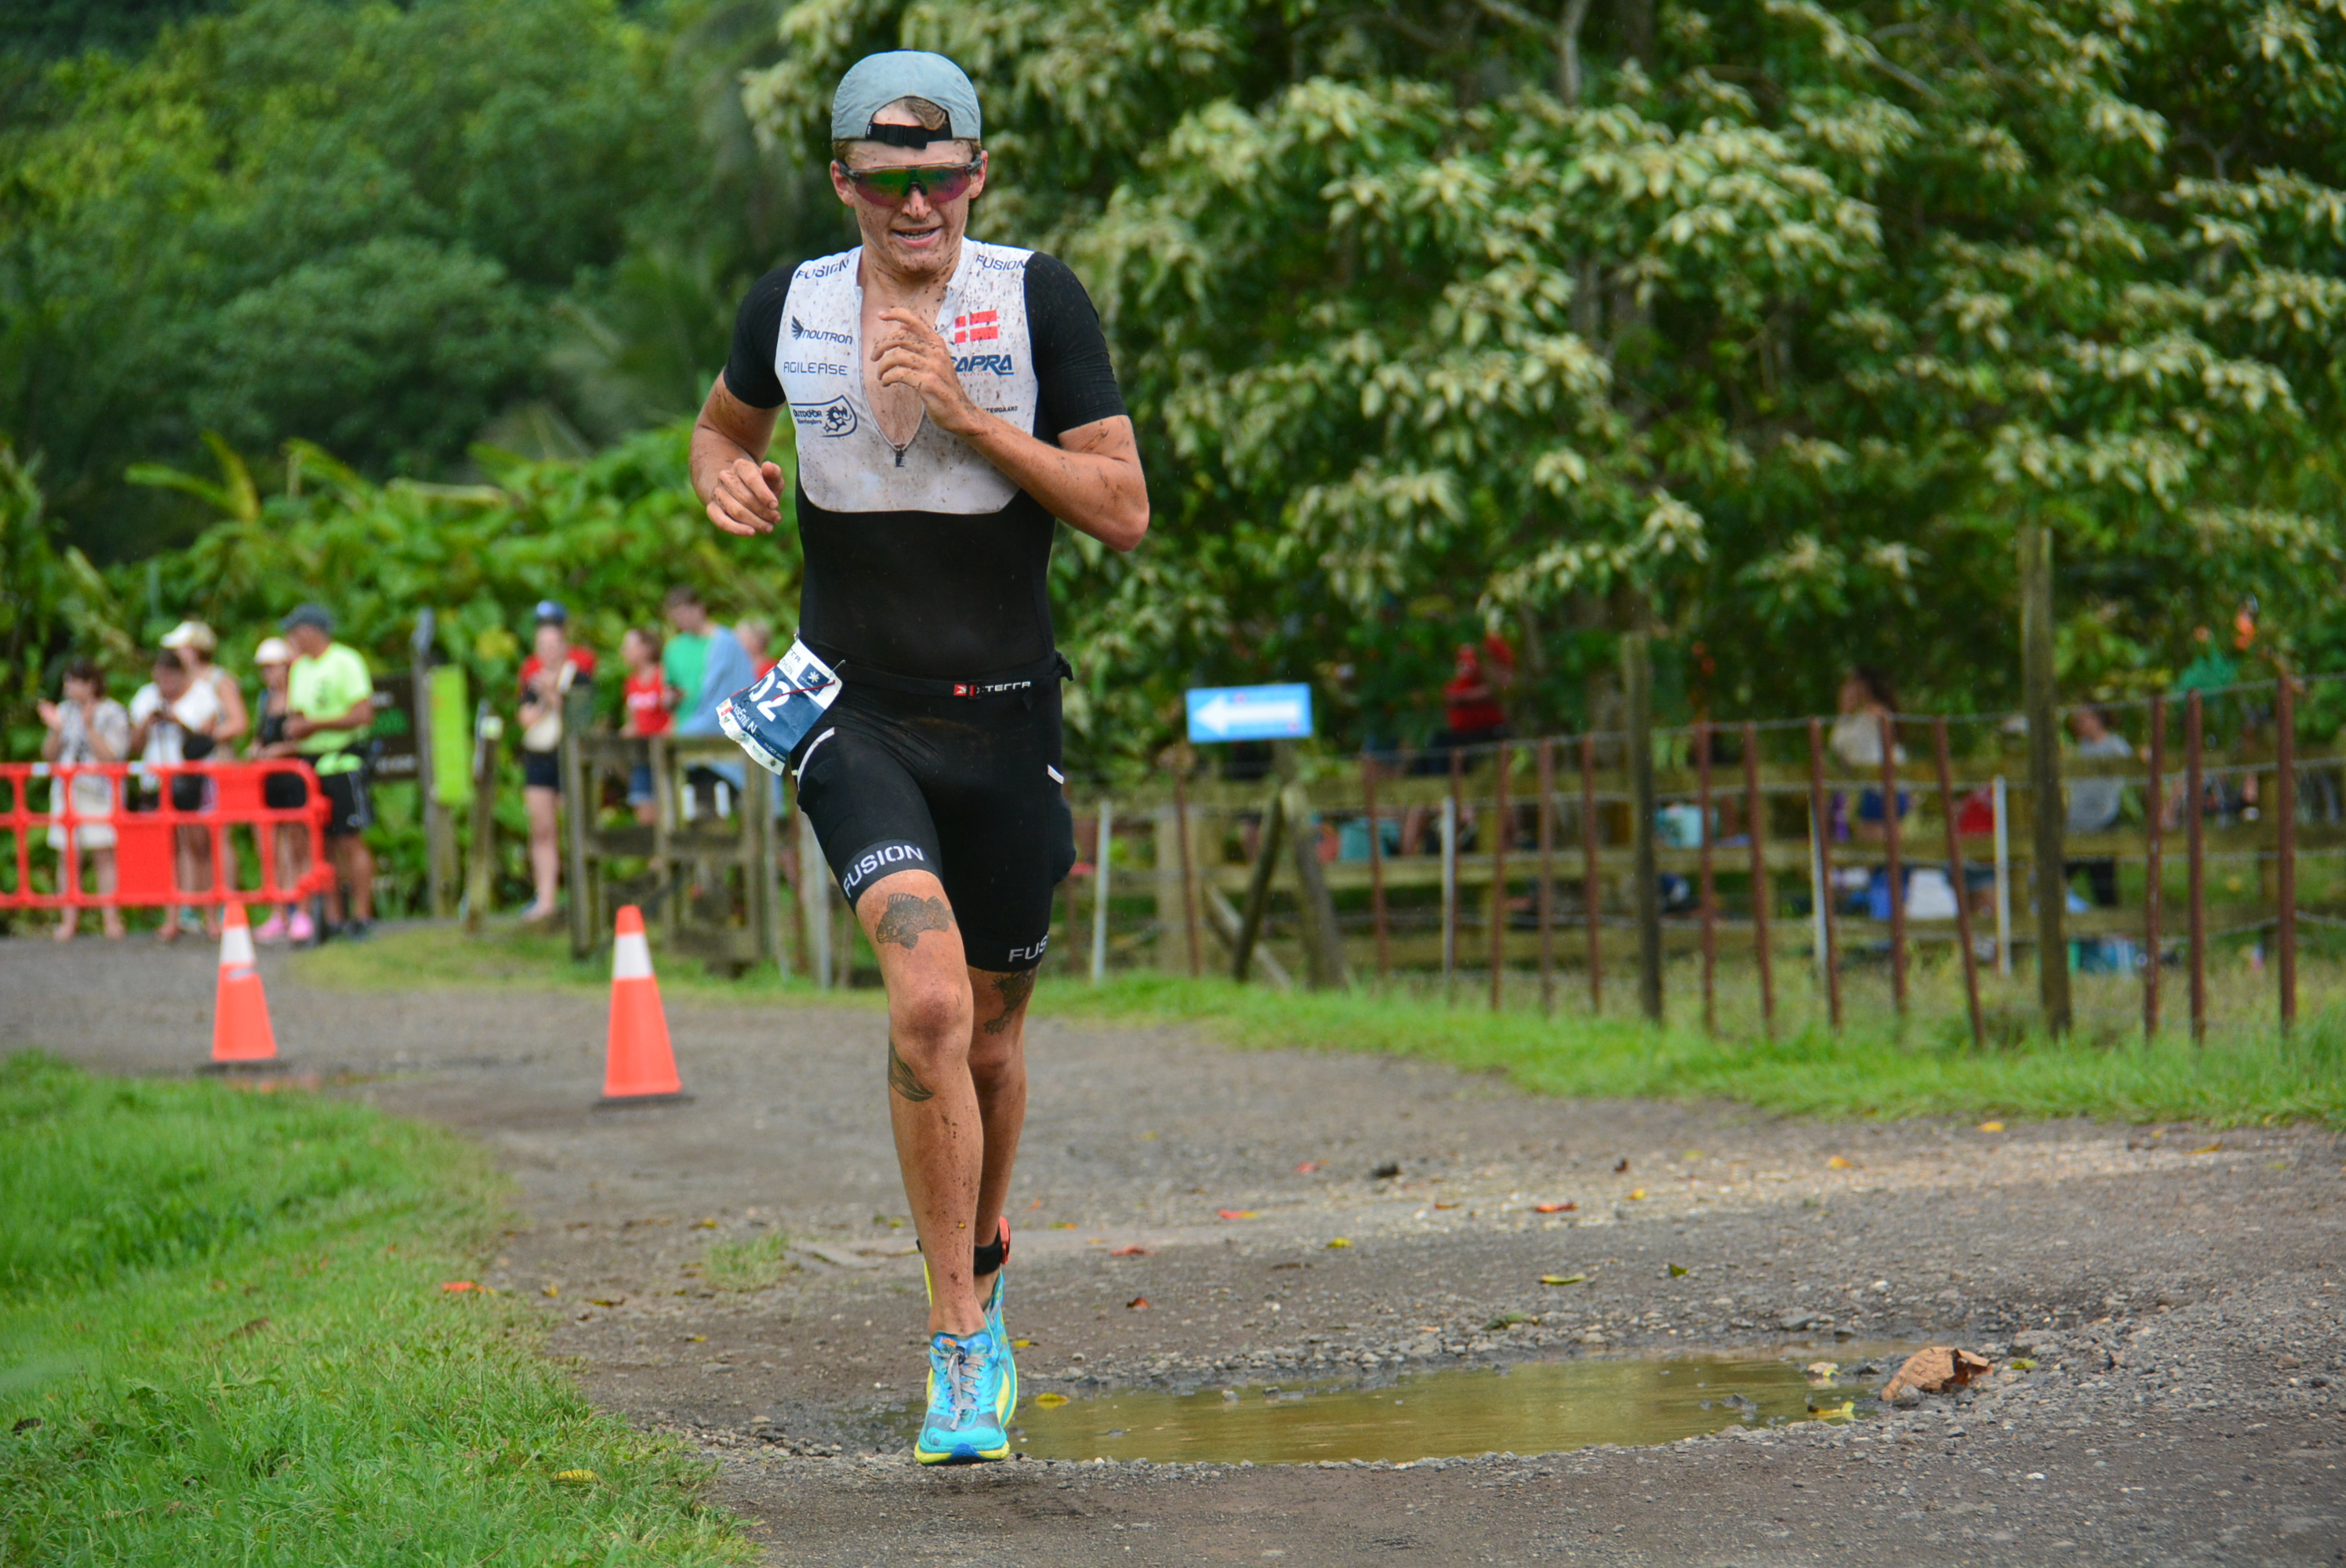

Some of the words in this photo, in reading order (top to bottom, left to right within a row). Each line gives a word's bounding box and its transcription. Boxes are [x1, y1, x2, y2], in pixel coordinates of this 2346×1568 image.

[795, 258, 850, 279] FUSION
[975, 253, 1026, 271] FUSION
[784, 361, 848, 376] AGILEASE
[984, 405, 1019, 414] TERGAARD
[843, 844, 925, 899] FUSION
[1008, 931, 1049, 963] FUS
